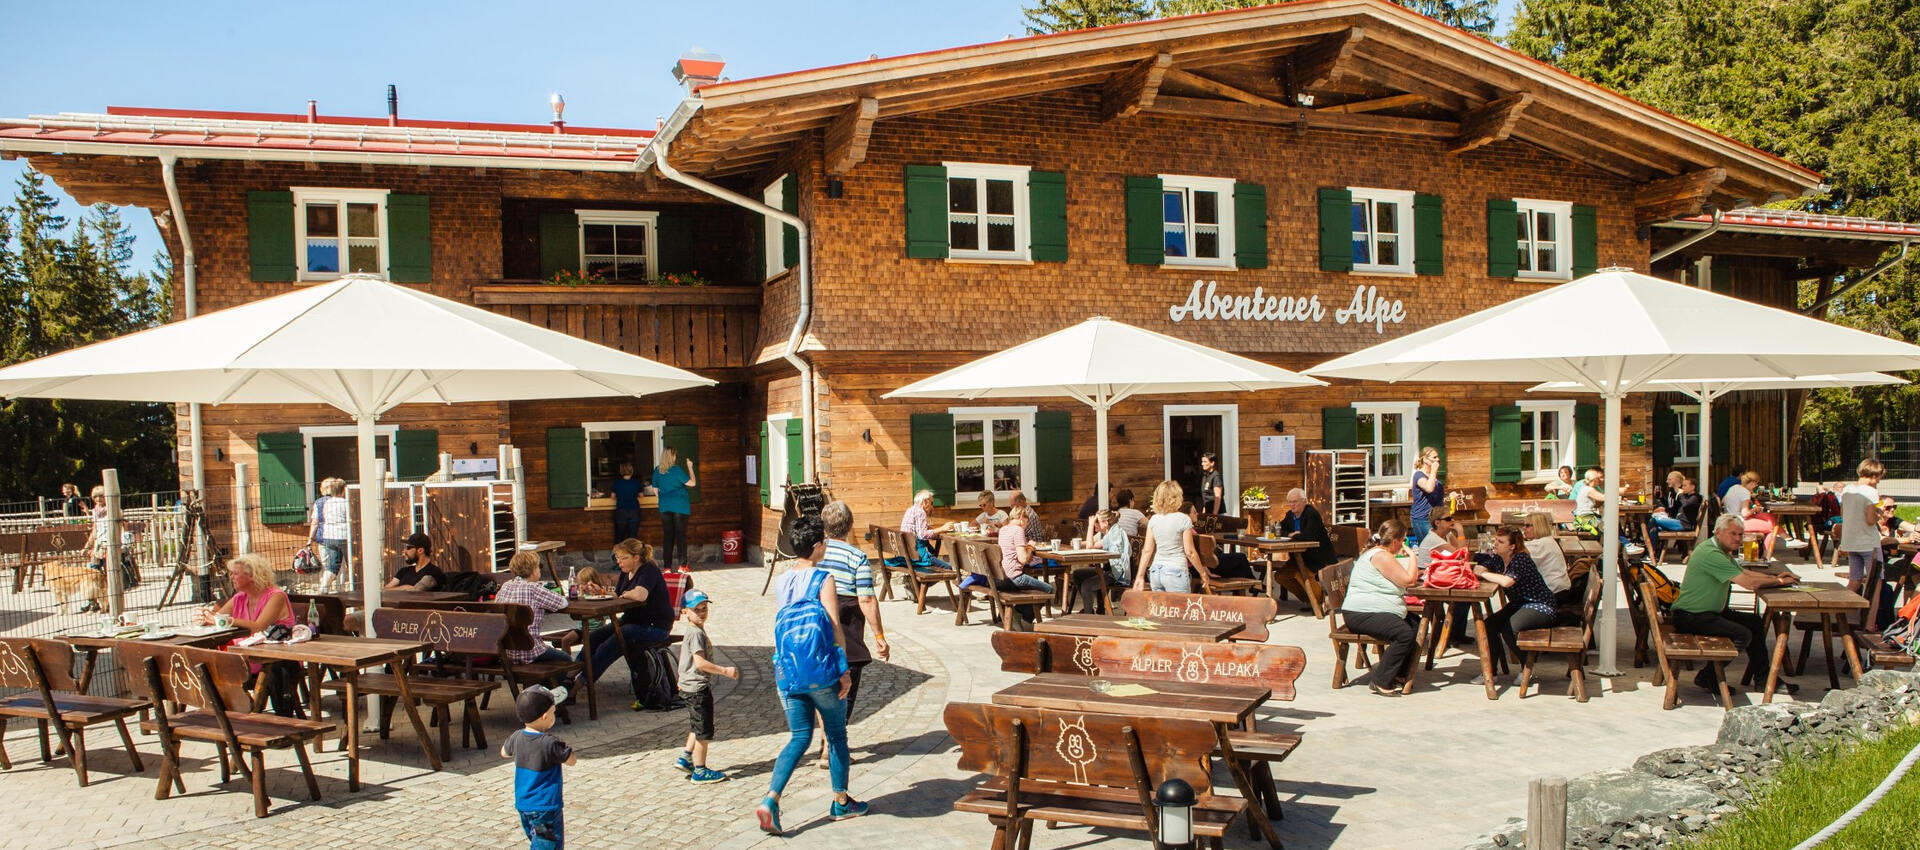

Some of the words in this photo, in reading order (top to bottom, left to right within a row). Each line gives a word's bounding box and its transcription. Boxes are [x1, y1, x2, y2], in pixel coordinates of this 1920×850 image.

[1170, 279, 1326, 322] Abenteuer
[1335, 284, 1407, 334] Alpe
[1209, 609, 1244, 623] ALPAKA
[392, 620, 419, 634] ÄLPLER
[453, 626, 479, 638] SCHAF
[1131, 655, 1172, 673] ÄLPLER
[1214, 662, 1260, 677] ALPAKA
